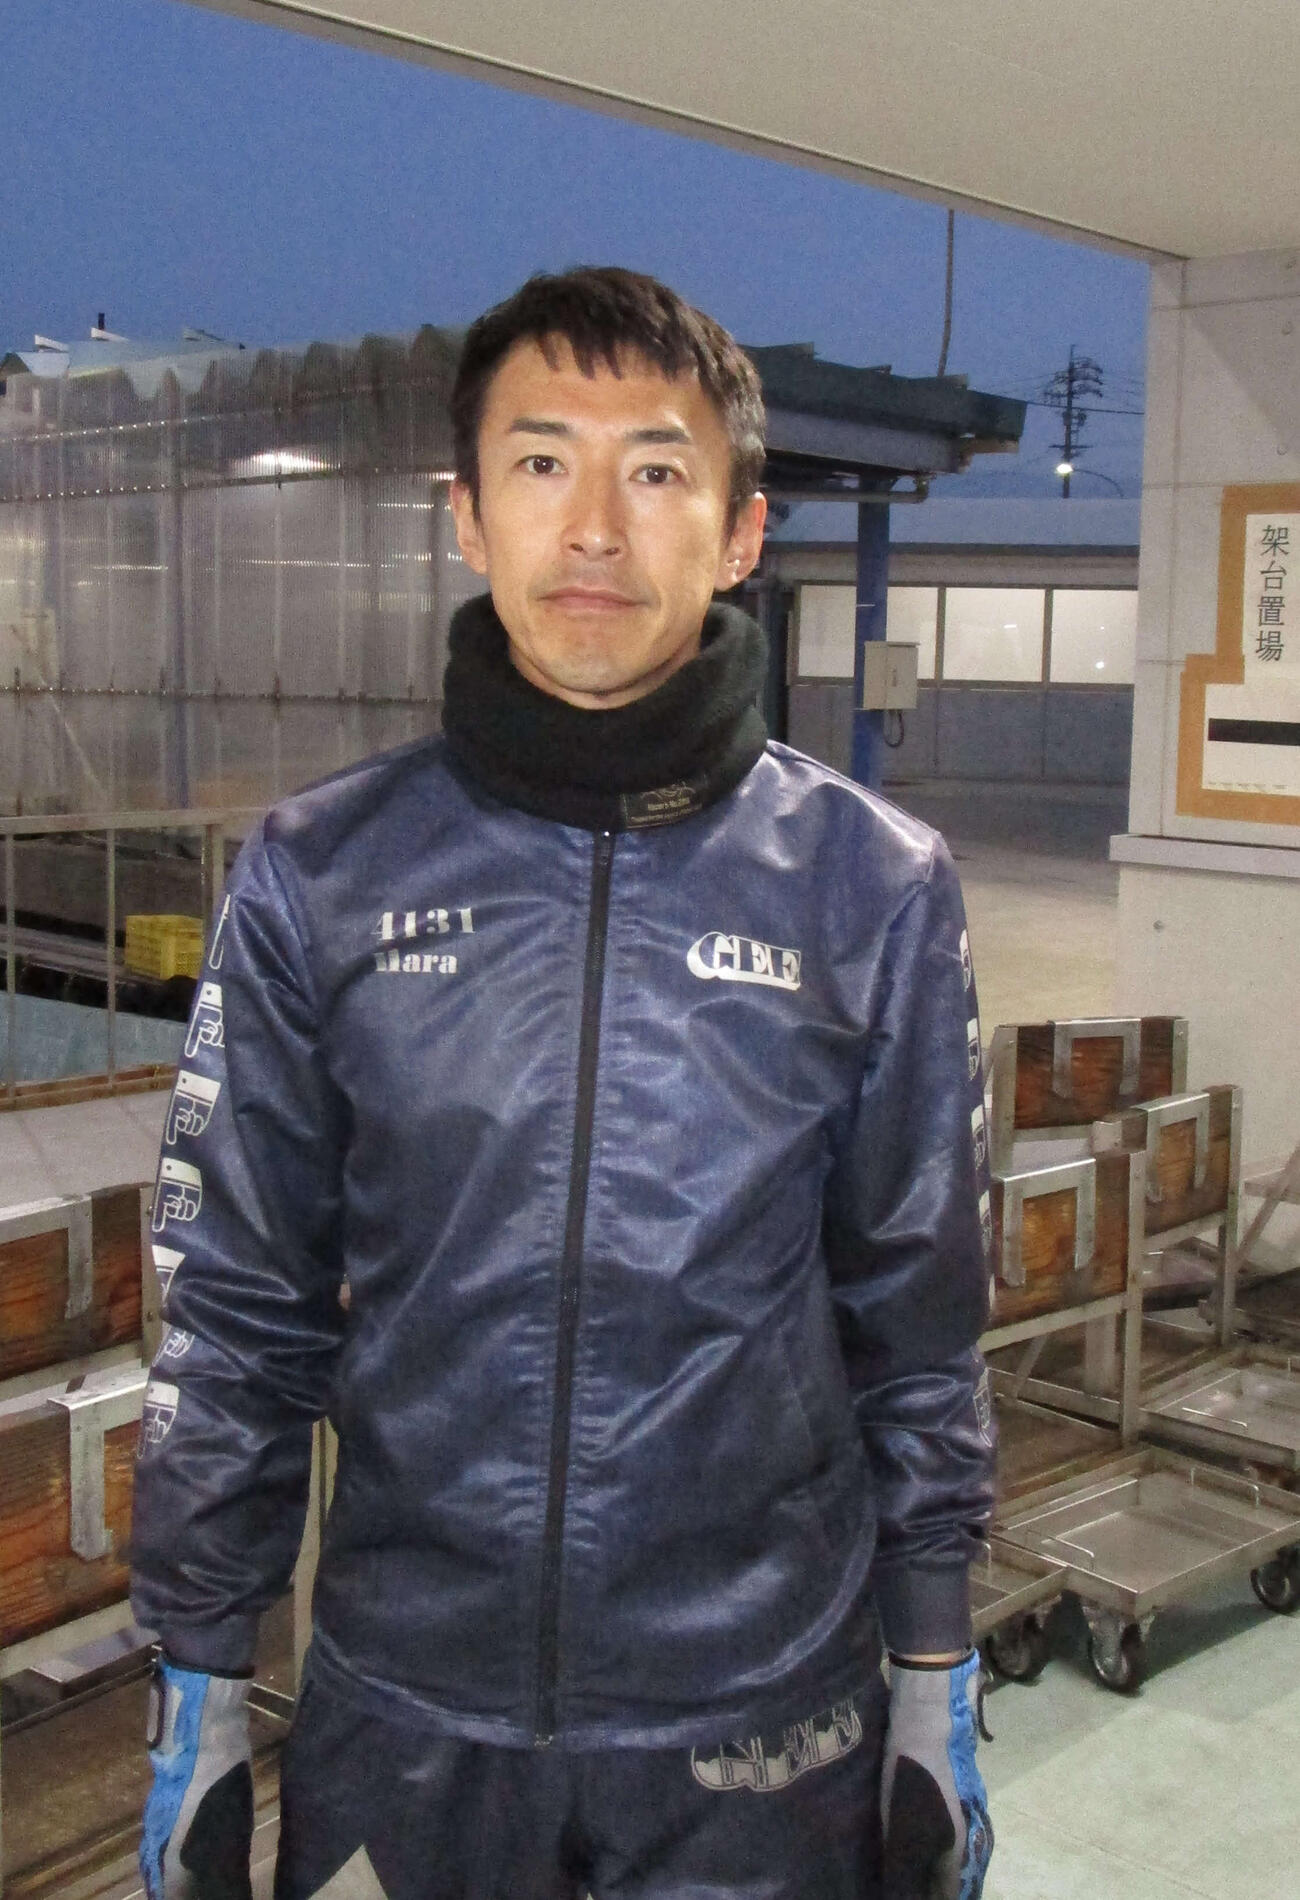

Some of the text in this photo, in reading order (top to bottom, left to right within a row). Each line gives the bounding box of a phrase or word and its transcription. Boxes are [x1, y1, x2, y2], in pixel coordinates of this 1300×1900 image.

[1255, 524, 1289, 662] 架台置場
[371, 907, 475, 940] 4131
